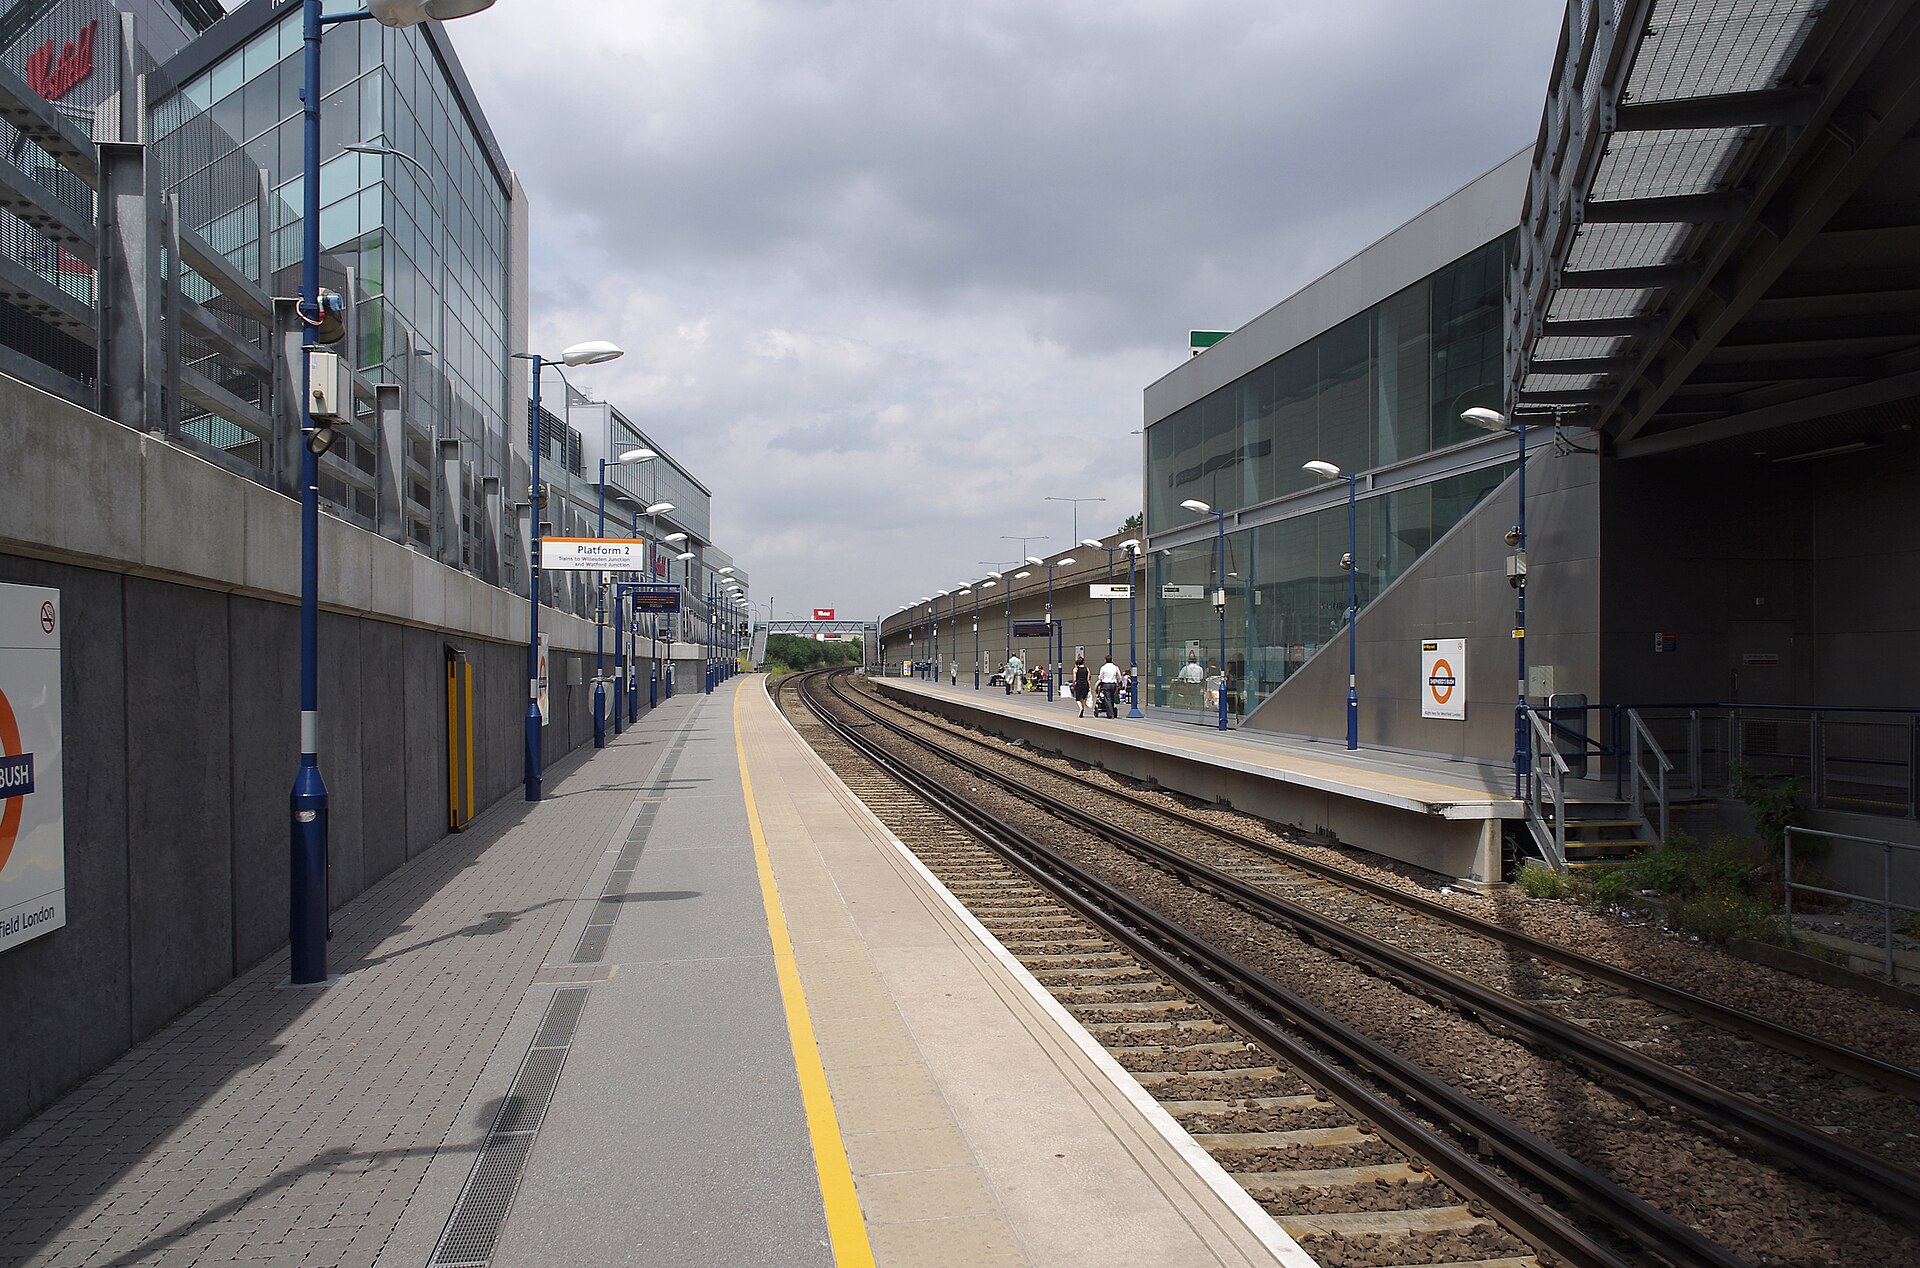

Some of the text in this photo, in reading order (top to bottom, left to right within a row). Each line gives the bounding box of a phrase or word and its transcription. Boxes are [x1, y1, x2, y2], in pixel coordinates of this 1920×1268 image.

[577, 546, 621, 554] Platform
[0, 765, 29, 788] BUSH
[22, 906, 54, 929] London
